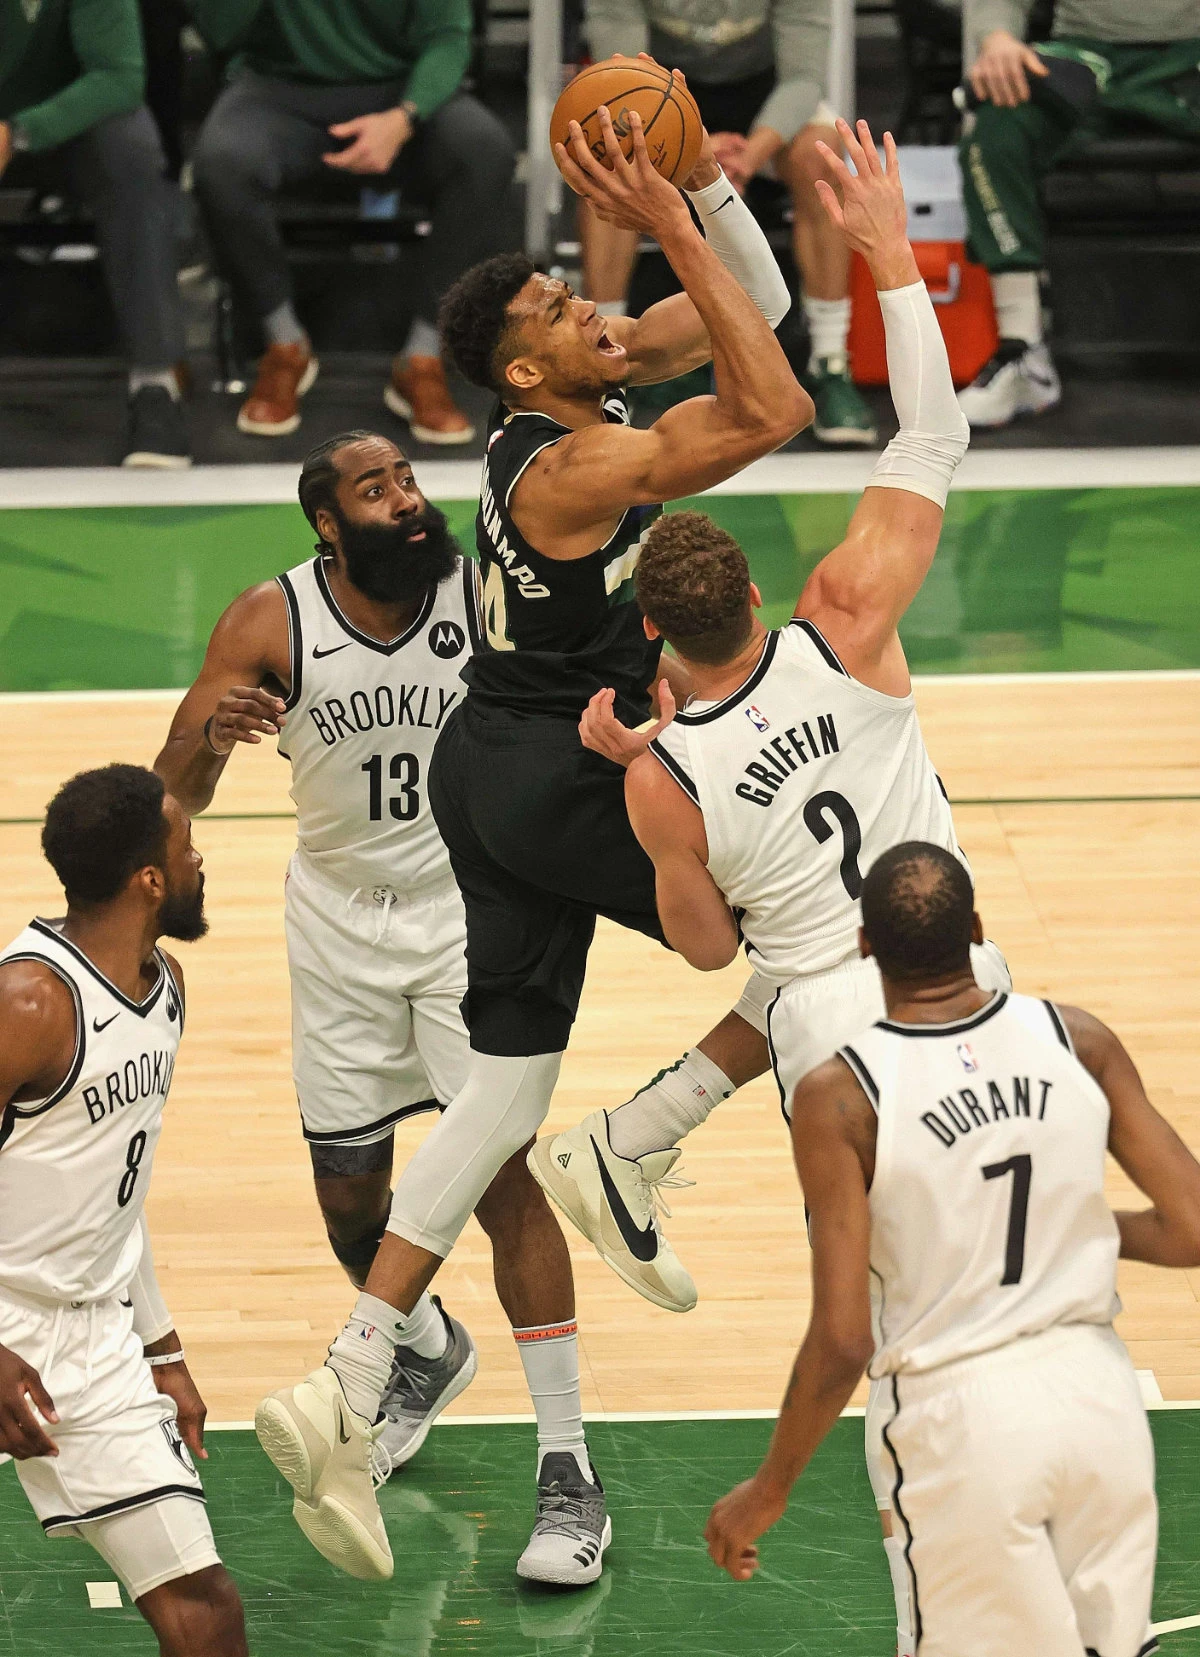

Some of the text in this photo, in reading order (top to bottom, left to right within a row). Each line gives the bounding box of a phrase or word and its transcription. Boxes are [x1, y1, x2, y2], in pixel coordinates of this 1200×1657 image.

[309, 684, 457, 746] BROOKLY
[361, 752, 420, 822] 13
[735, 713, 840, 808] GRIFFIN
[803, 790, 862, 902] 2
[82, 1050, 176, 1125] BROOKL
[919, 1074, 1053, 1149] DURANT
[117, 1130, 146, 1207] 8
[980, 1153, 1032, 1287] 7
